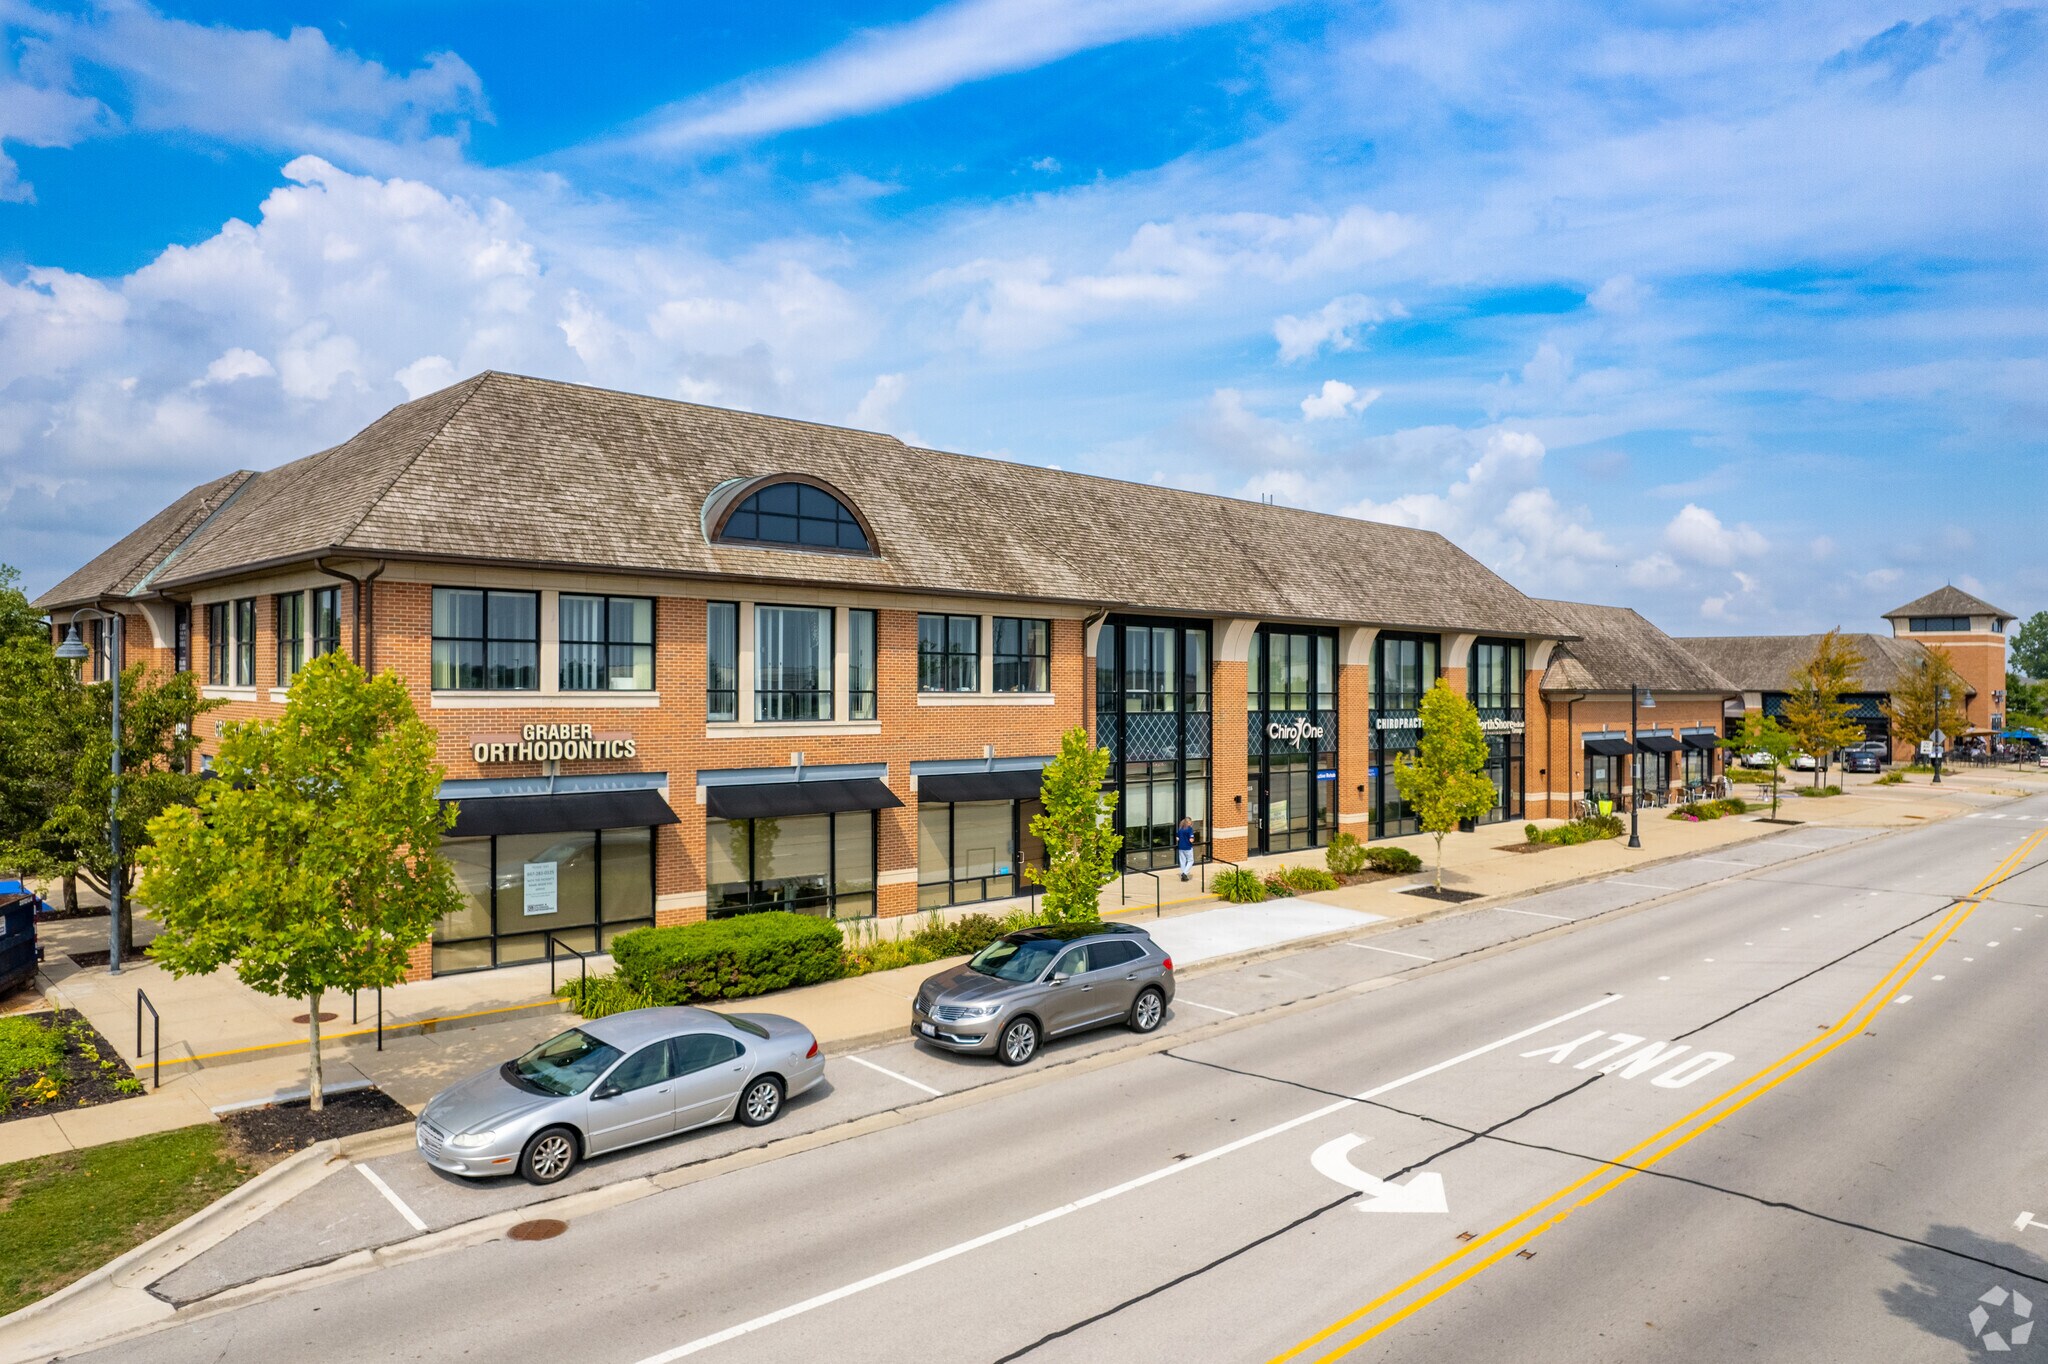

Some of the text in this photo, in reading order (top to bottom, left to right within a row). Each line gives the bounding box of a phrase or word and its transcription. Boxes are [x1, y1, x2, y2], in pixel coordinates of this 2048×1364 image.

[523, 724, 592, 740] GRABER
[1376, 717, 1425, 730] CHIROPRACT
[474, 739, 636, 763] ORTHODONTICS
[1519, 1030, 1735, 1088] ONLY
